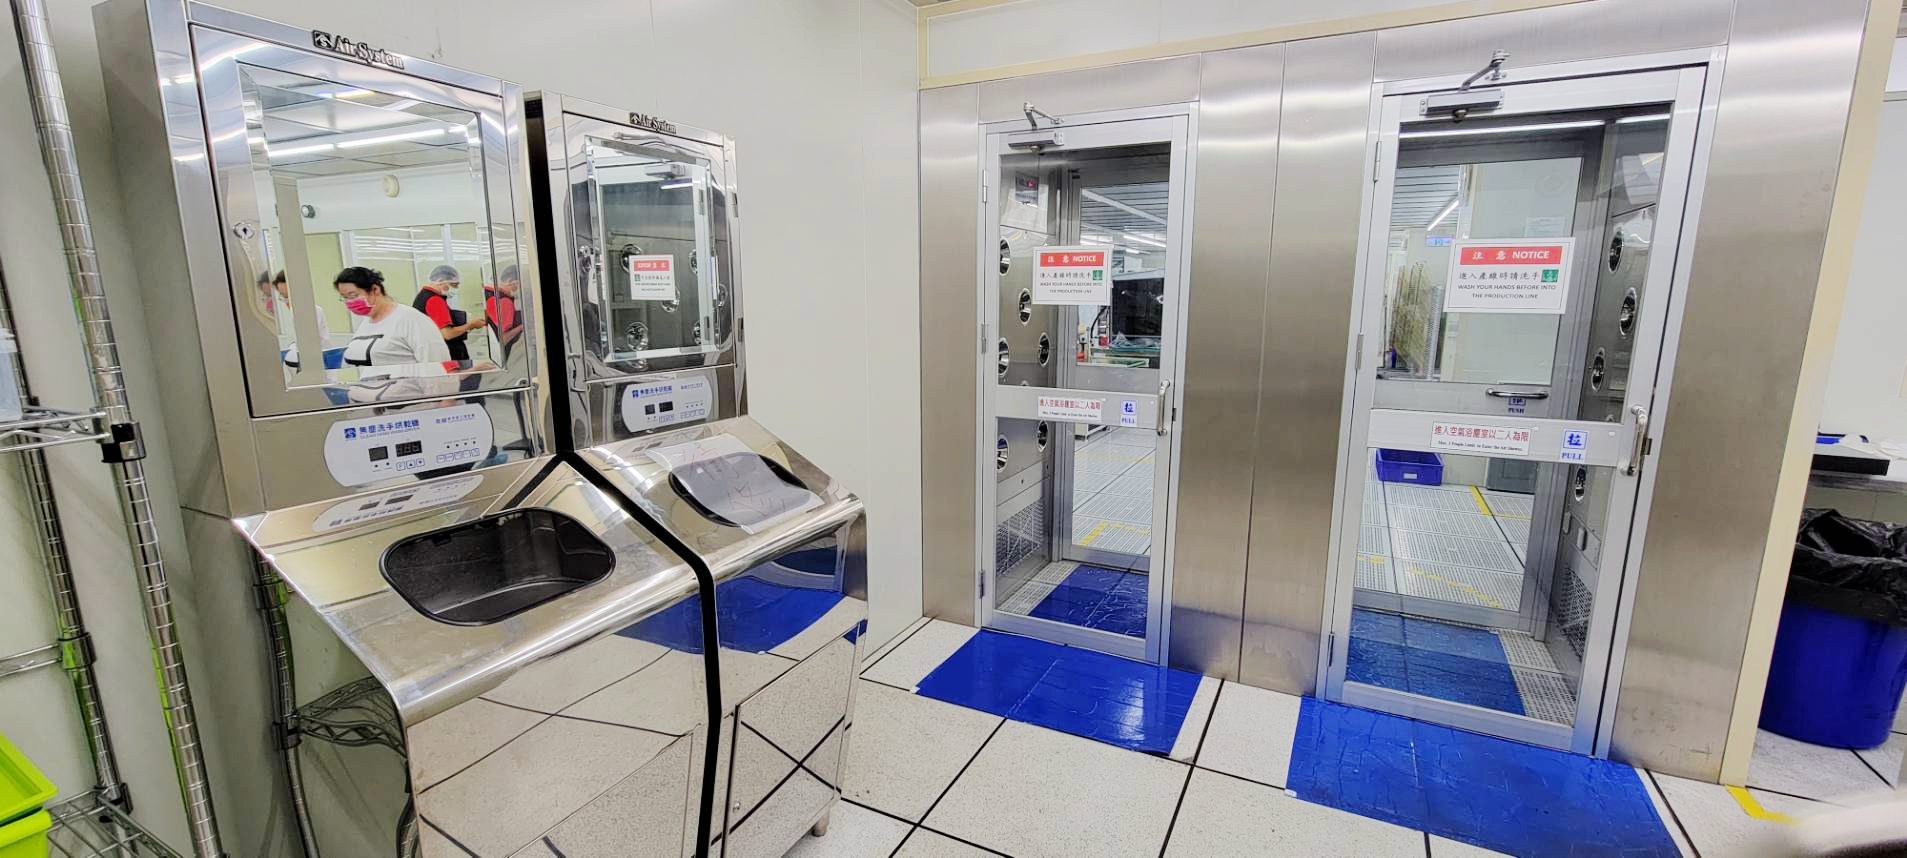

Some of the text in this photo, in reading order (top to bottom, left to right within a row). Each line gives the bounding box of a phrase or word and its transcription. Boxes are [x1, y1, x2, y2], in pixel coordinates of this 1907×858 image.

[335, 35, 404, 69] Air System
[640, 114, 677, 134] Air System
[1072, 255, 1097, 263] NOTICE
[1512, 251, 1550, 260] NOTICE
[1567, 433, 1582, 446] 拉
[1562, 452, 1582, 460] PULL
